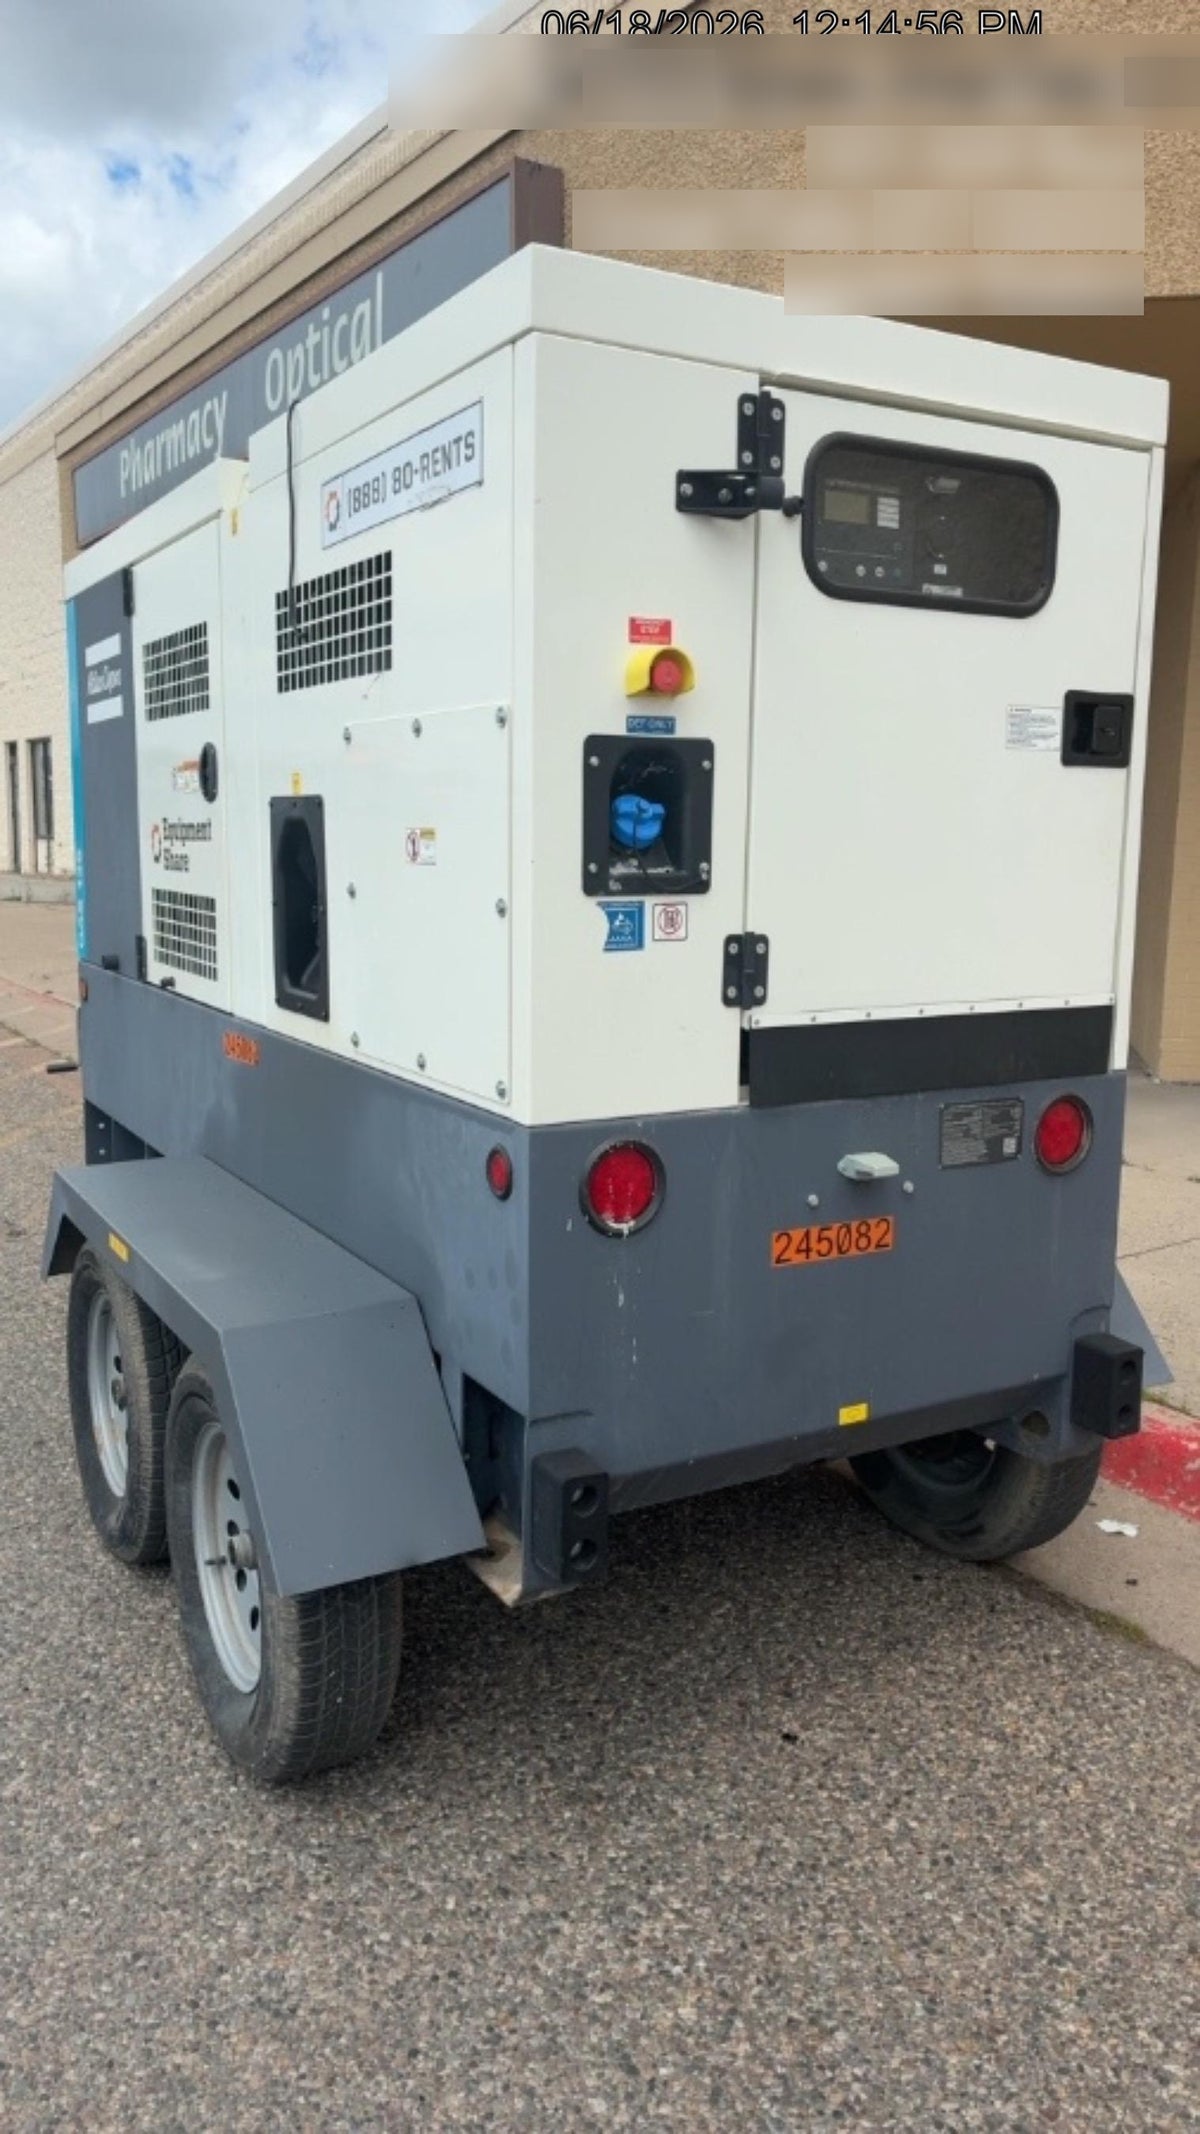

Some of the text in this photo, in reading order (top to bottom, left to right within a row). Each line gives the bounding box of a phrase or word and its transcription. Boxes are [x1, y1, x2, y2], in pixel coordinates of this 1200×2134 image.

[120, 270, 383, 498] Pharmacy Optical
[162, 817, 212, 847] Equipment
[774, 1217, 891, 1265] 245082
